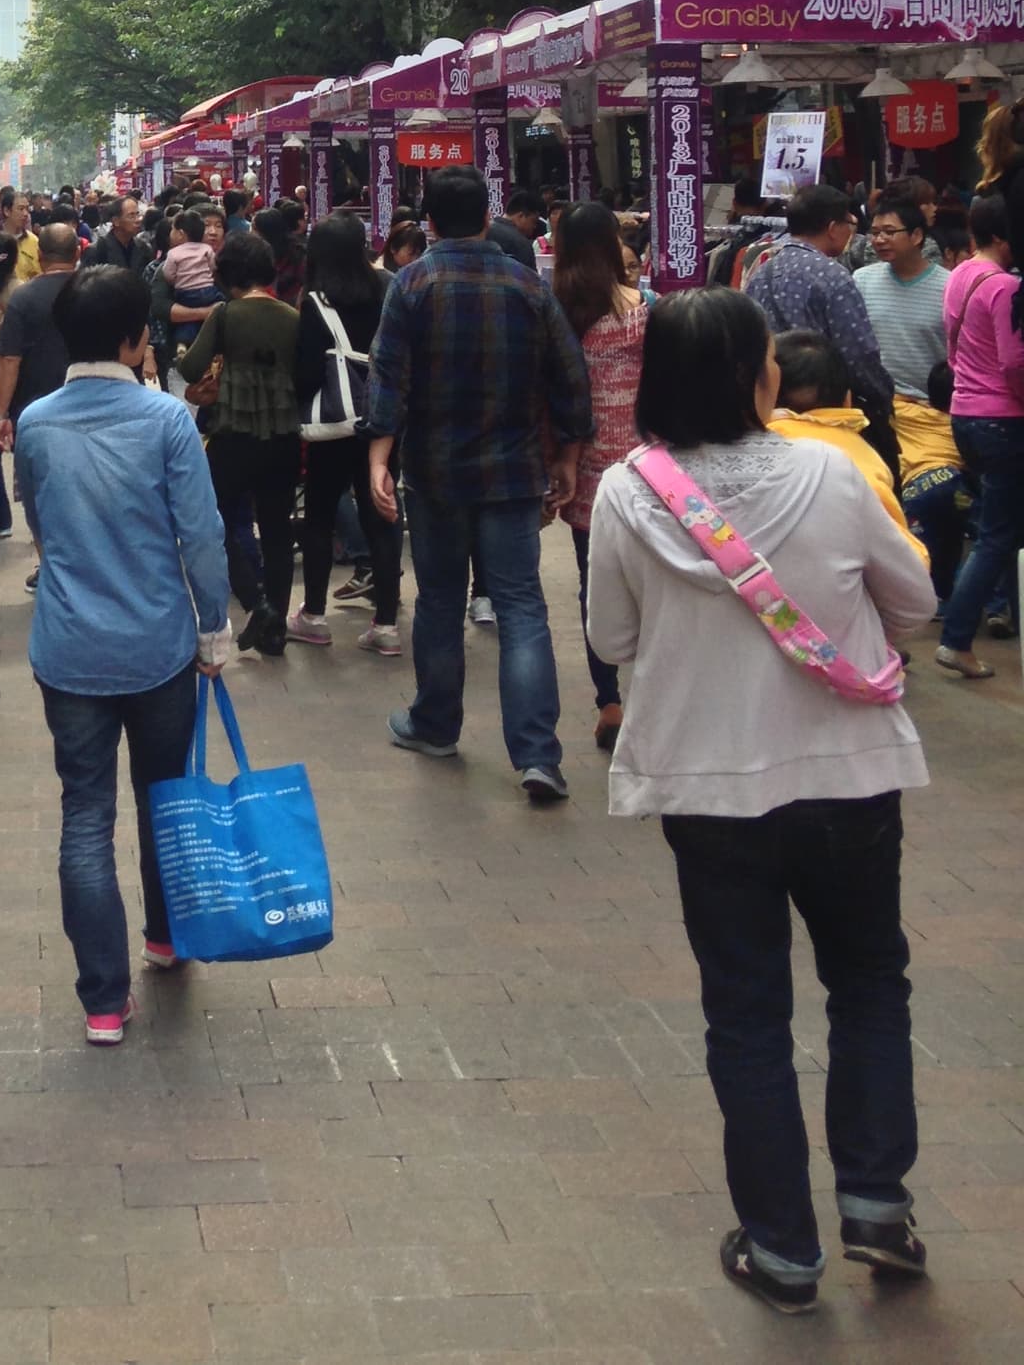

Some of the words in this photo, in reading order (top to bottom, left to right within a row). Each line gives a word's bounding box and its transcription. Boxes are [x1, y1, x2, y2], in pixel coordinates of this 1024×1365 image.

[674, 1, 801, 31] GrandBuy
[895, 102, 946, 134] 服务点
[410, 143, 462, 160] 服务点
[776, 147, 808, 171] 1.5
